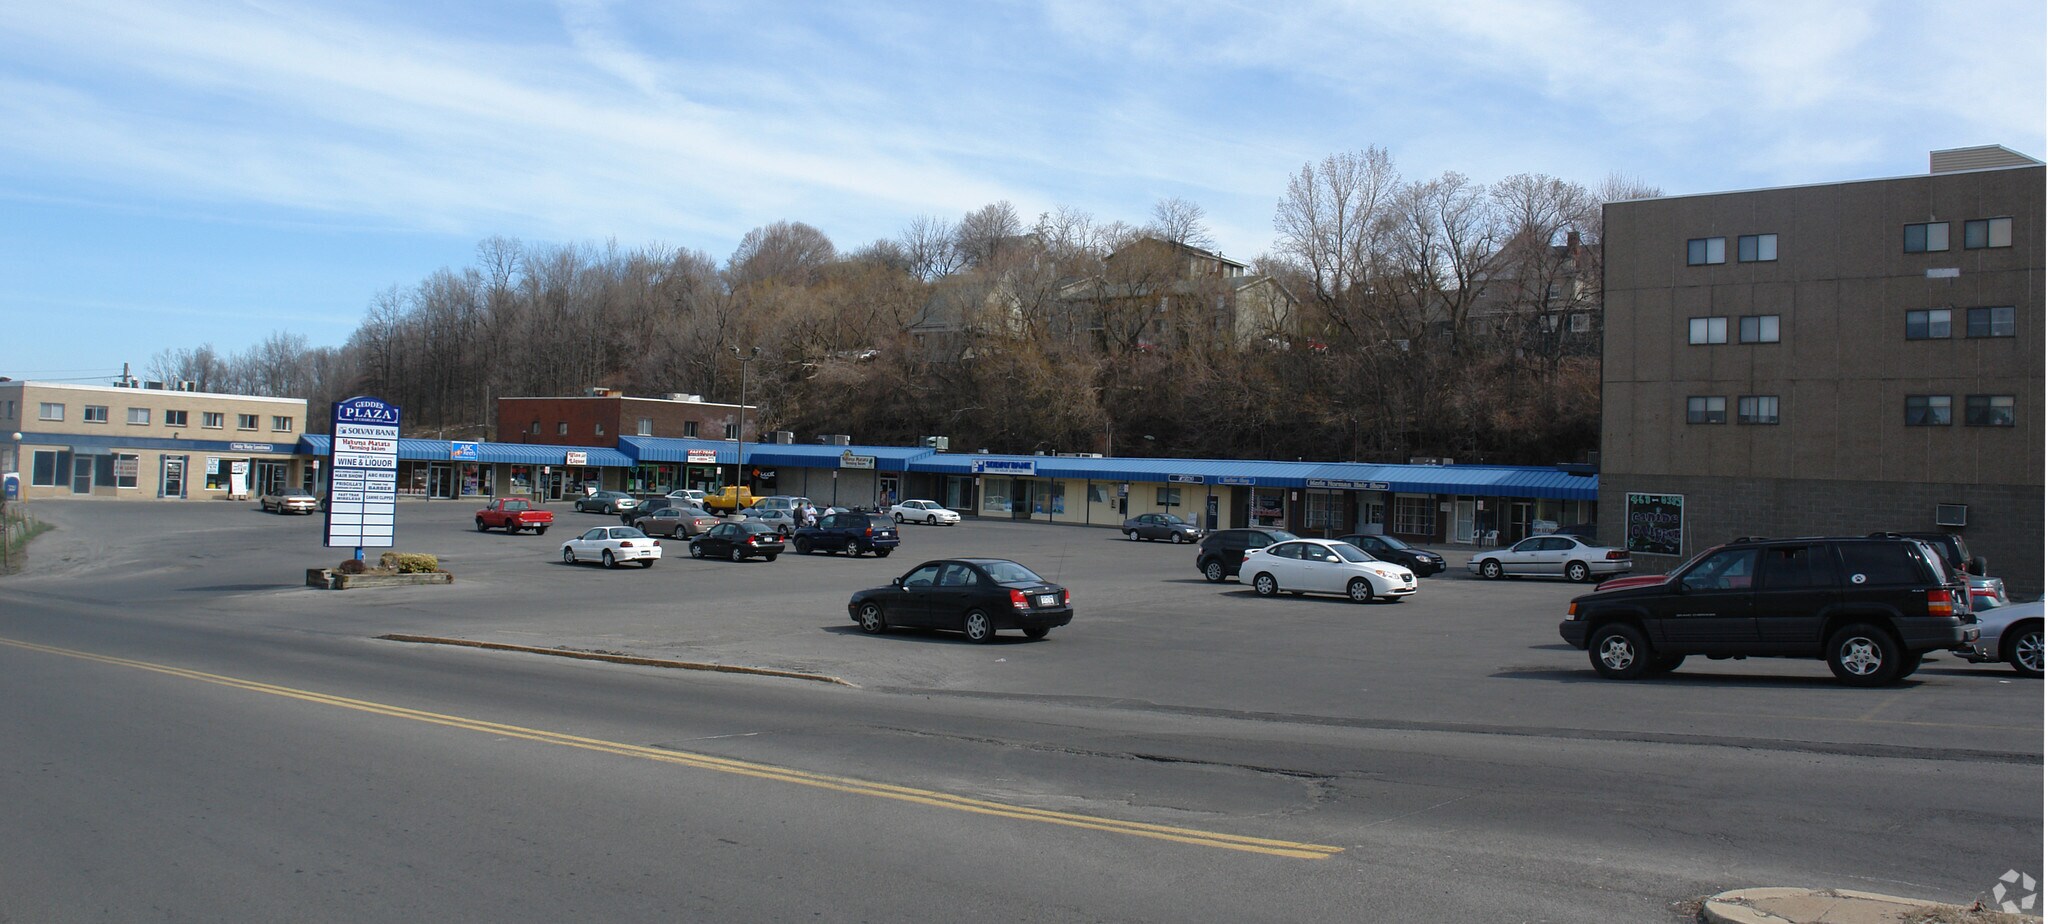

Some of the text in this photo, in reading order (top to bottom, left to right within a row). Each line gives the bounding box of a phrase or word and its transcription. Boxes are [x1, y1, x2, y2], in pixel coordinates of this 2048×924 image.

[355, 401, 384, 409] GEDDES
[346, 407, 391, 419] PLAZA
[348, 427, 374, 435] SOLVAY
[364, 459, 392, 467] LIQUOR
